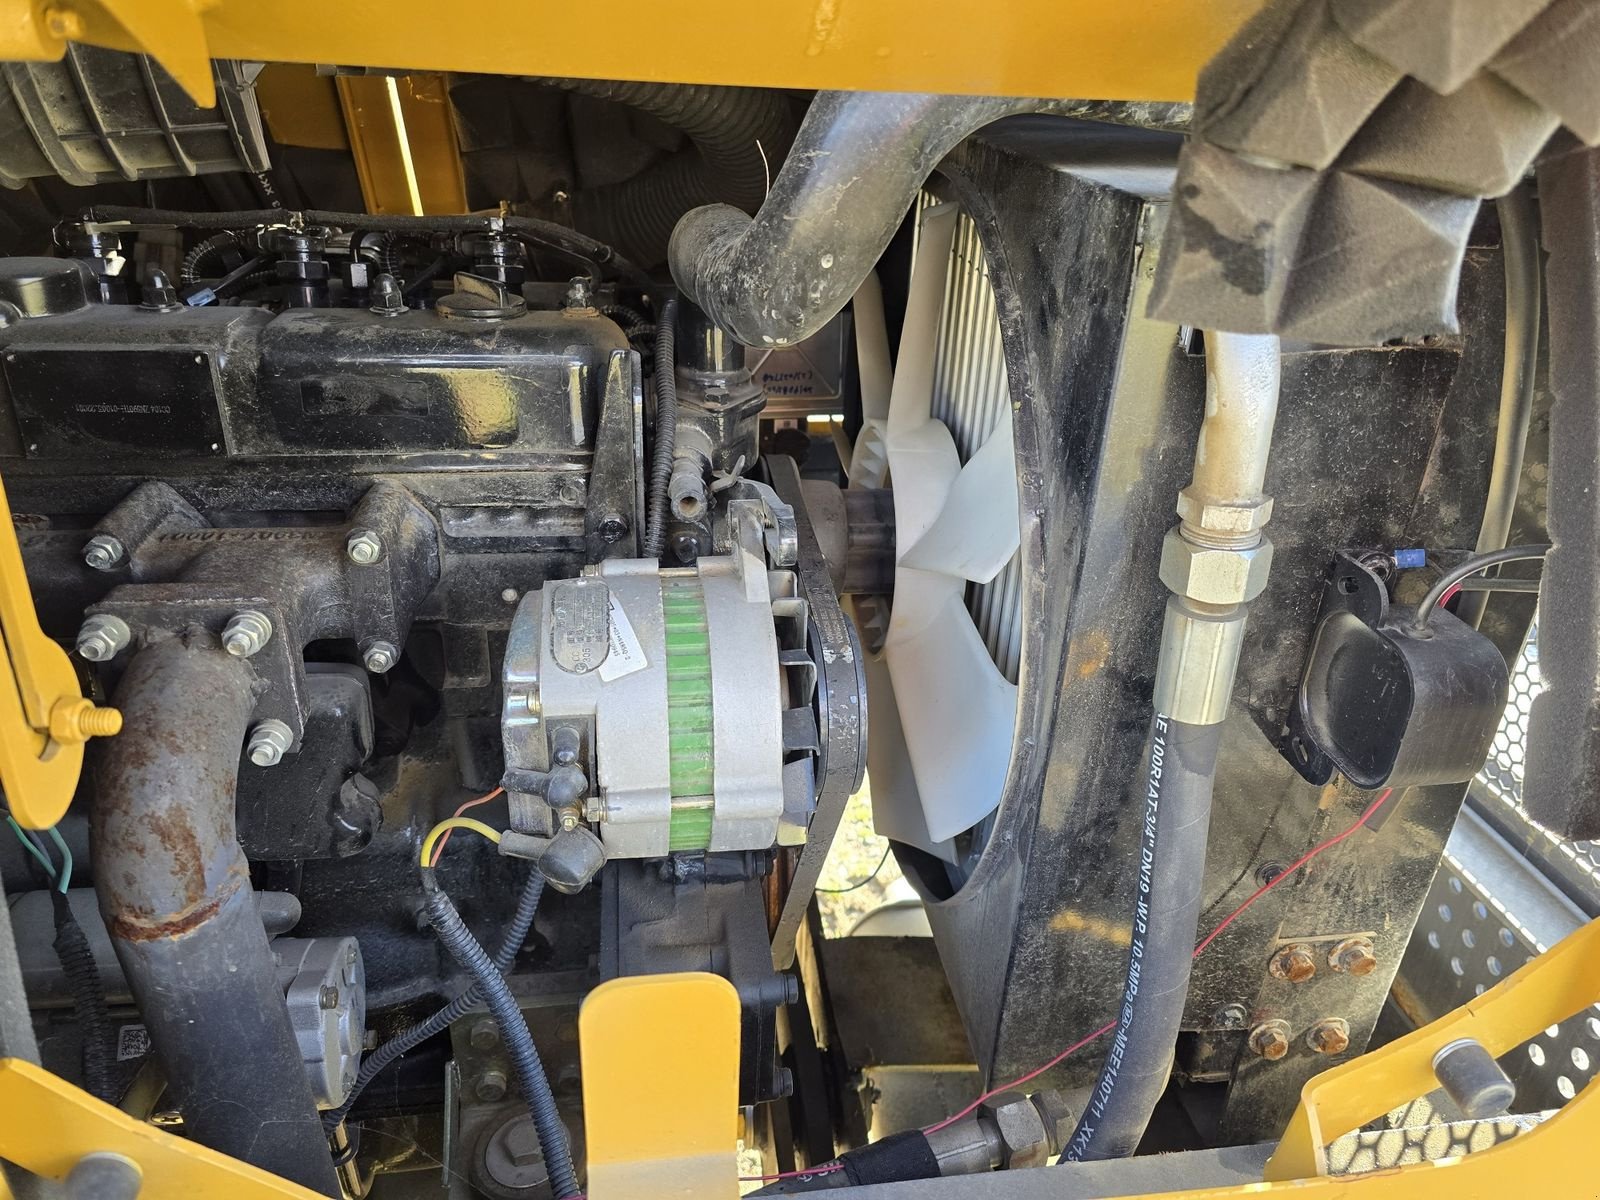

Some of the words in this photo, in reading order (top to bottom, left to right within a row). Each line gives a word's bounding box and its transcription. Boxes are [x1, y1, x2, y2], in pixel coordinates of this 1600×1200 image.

[1142, 736, 1166, 847] 100R1AT-3/4"
[1139, 847, 1153, 893] DN19
[1125, 938, 1144, 1007] 10.5MPa
